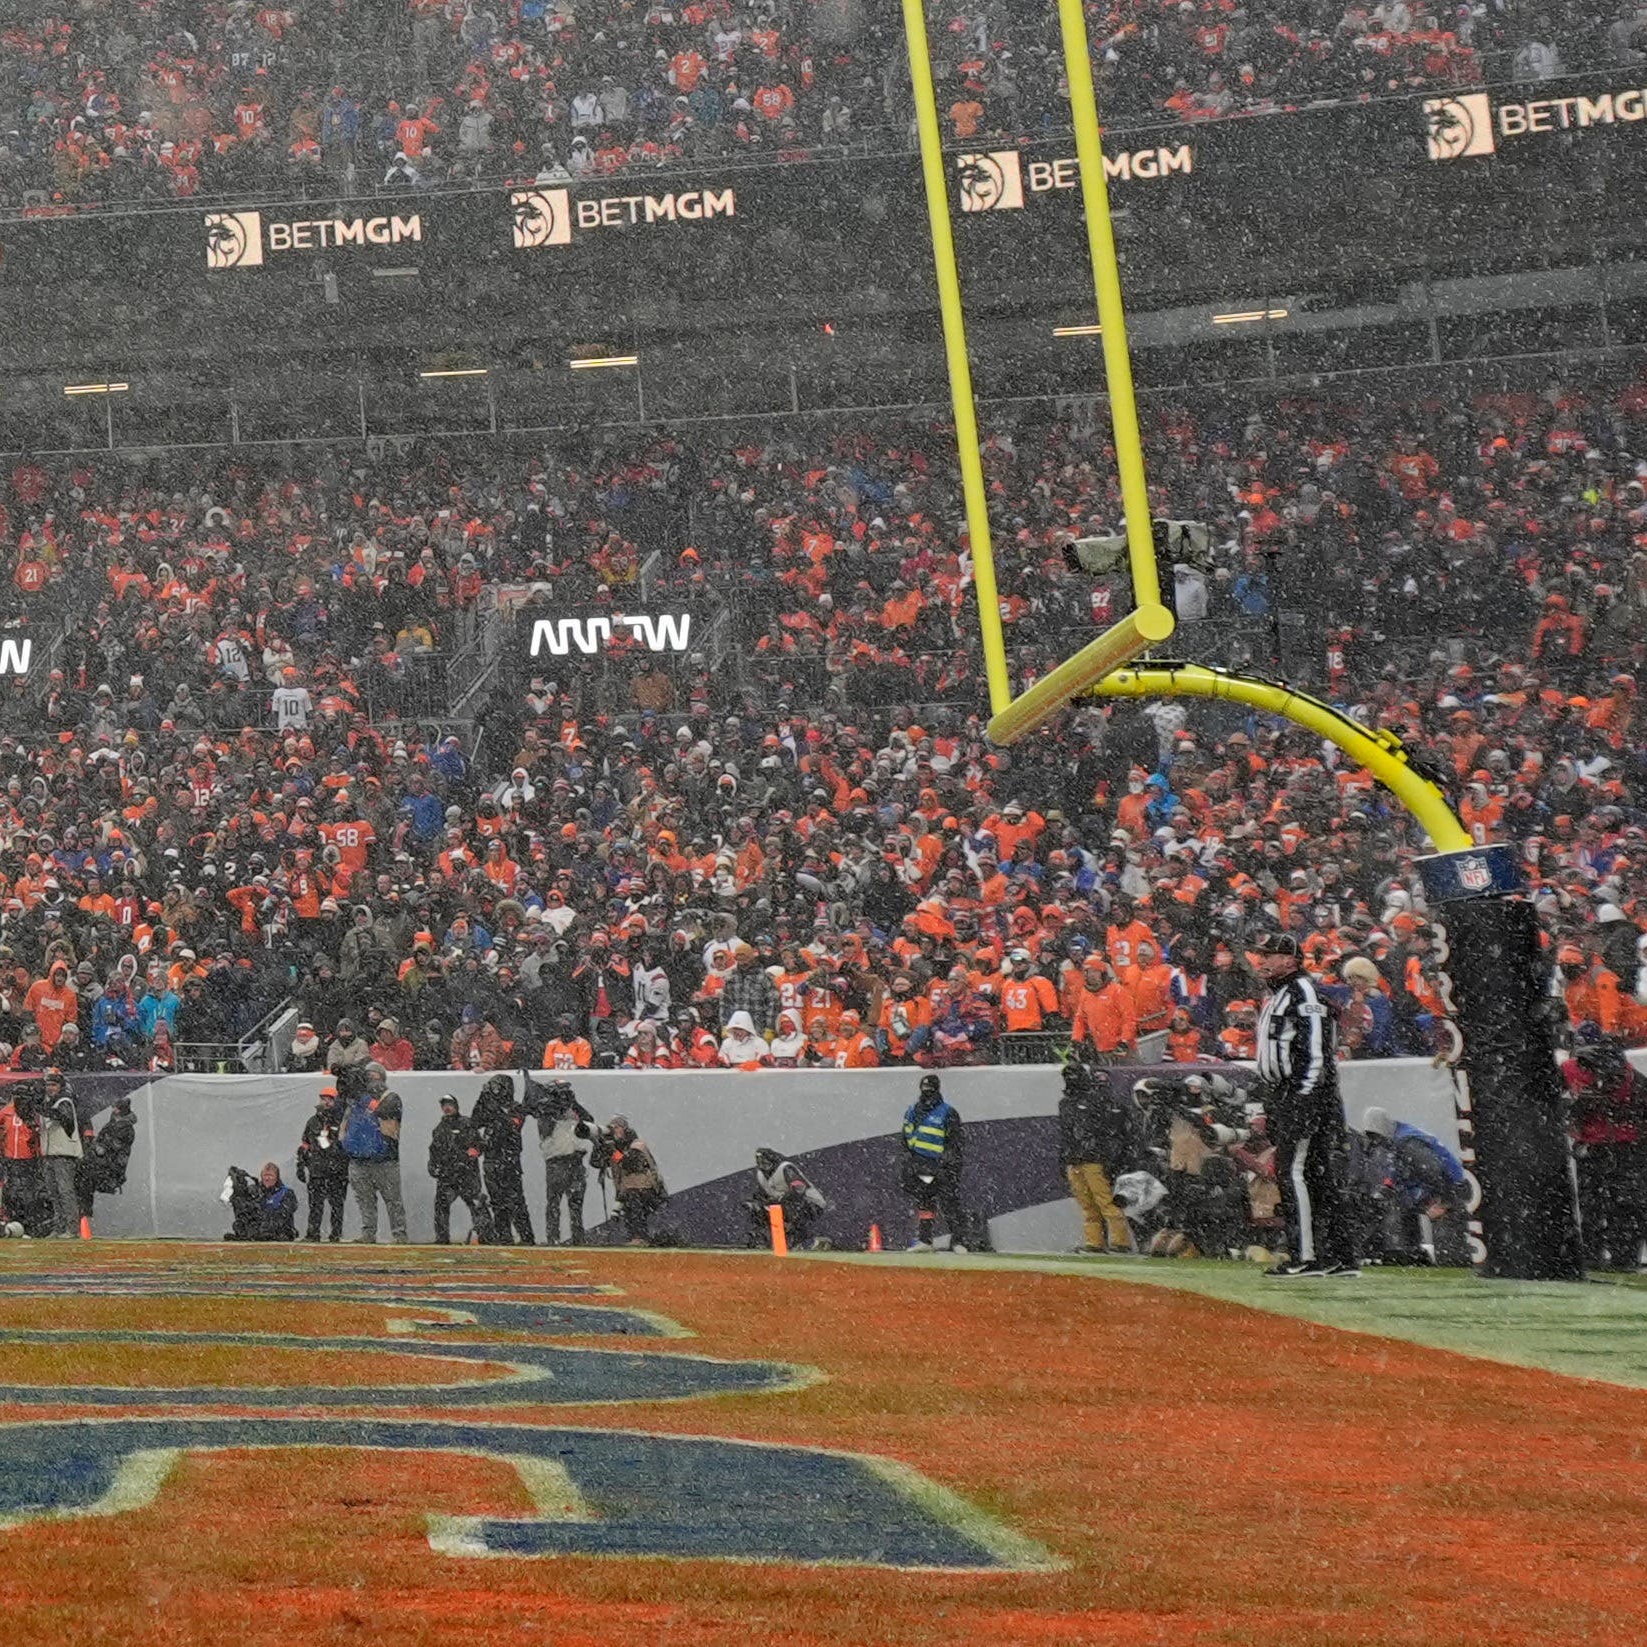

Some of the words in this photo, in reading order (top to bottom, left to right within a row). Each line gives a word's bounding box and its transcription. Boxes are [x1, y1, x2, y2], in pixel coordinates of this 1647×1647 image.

[680, 58, 690, 74] 2
[762, 92, 781, 108] 58
[241, 110, 255, 125] 10
[1500, 90, 1647, 136] BETMG
[404, 126, 417, 139] 10
[577, 189, 734, 228] BETMGM
[269, 215, 421, 251] BETMGM
[26, 568, 40, 583] 21
[224, 647, 240, 662] 12
[283, 699, 300, 718] 10
[565, 726, 575, 742] 7
[195, 788, 210, 806] 12
[336, 829, 359, 847] 58
[1464, 870, 1487, 887] NFL
